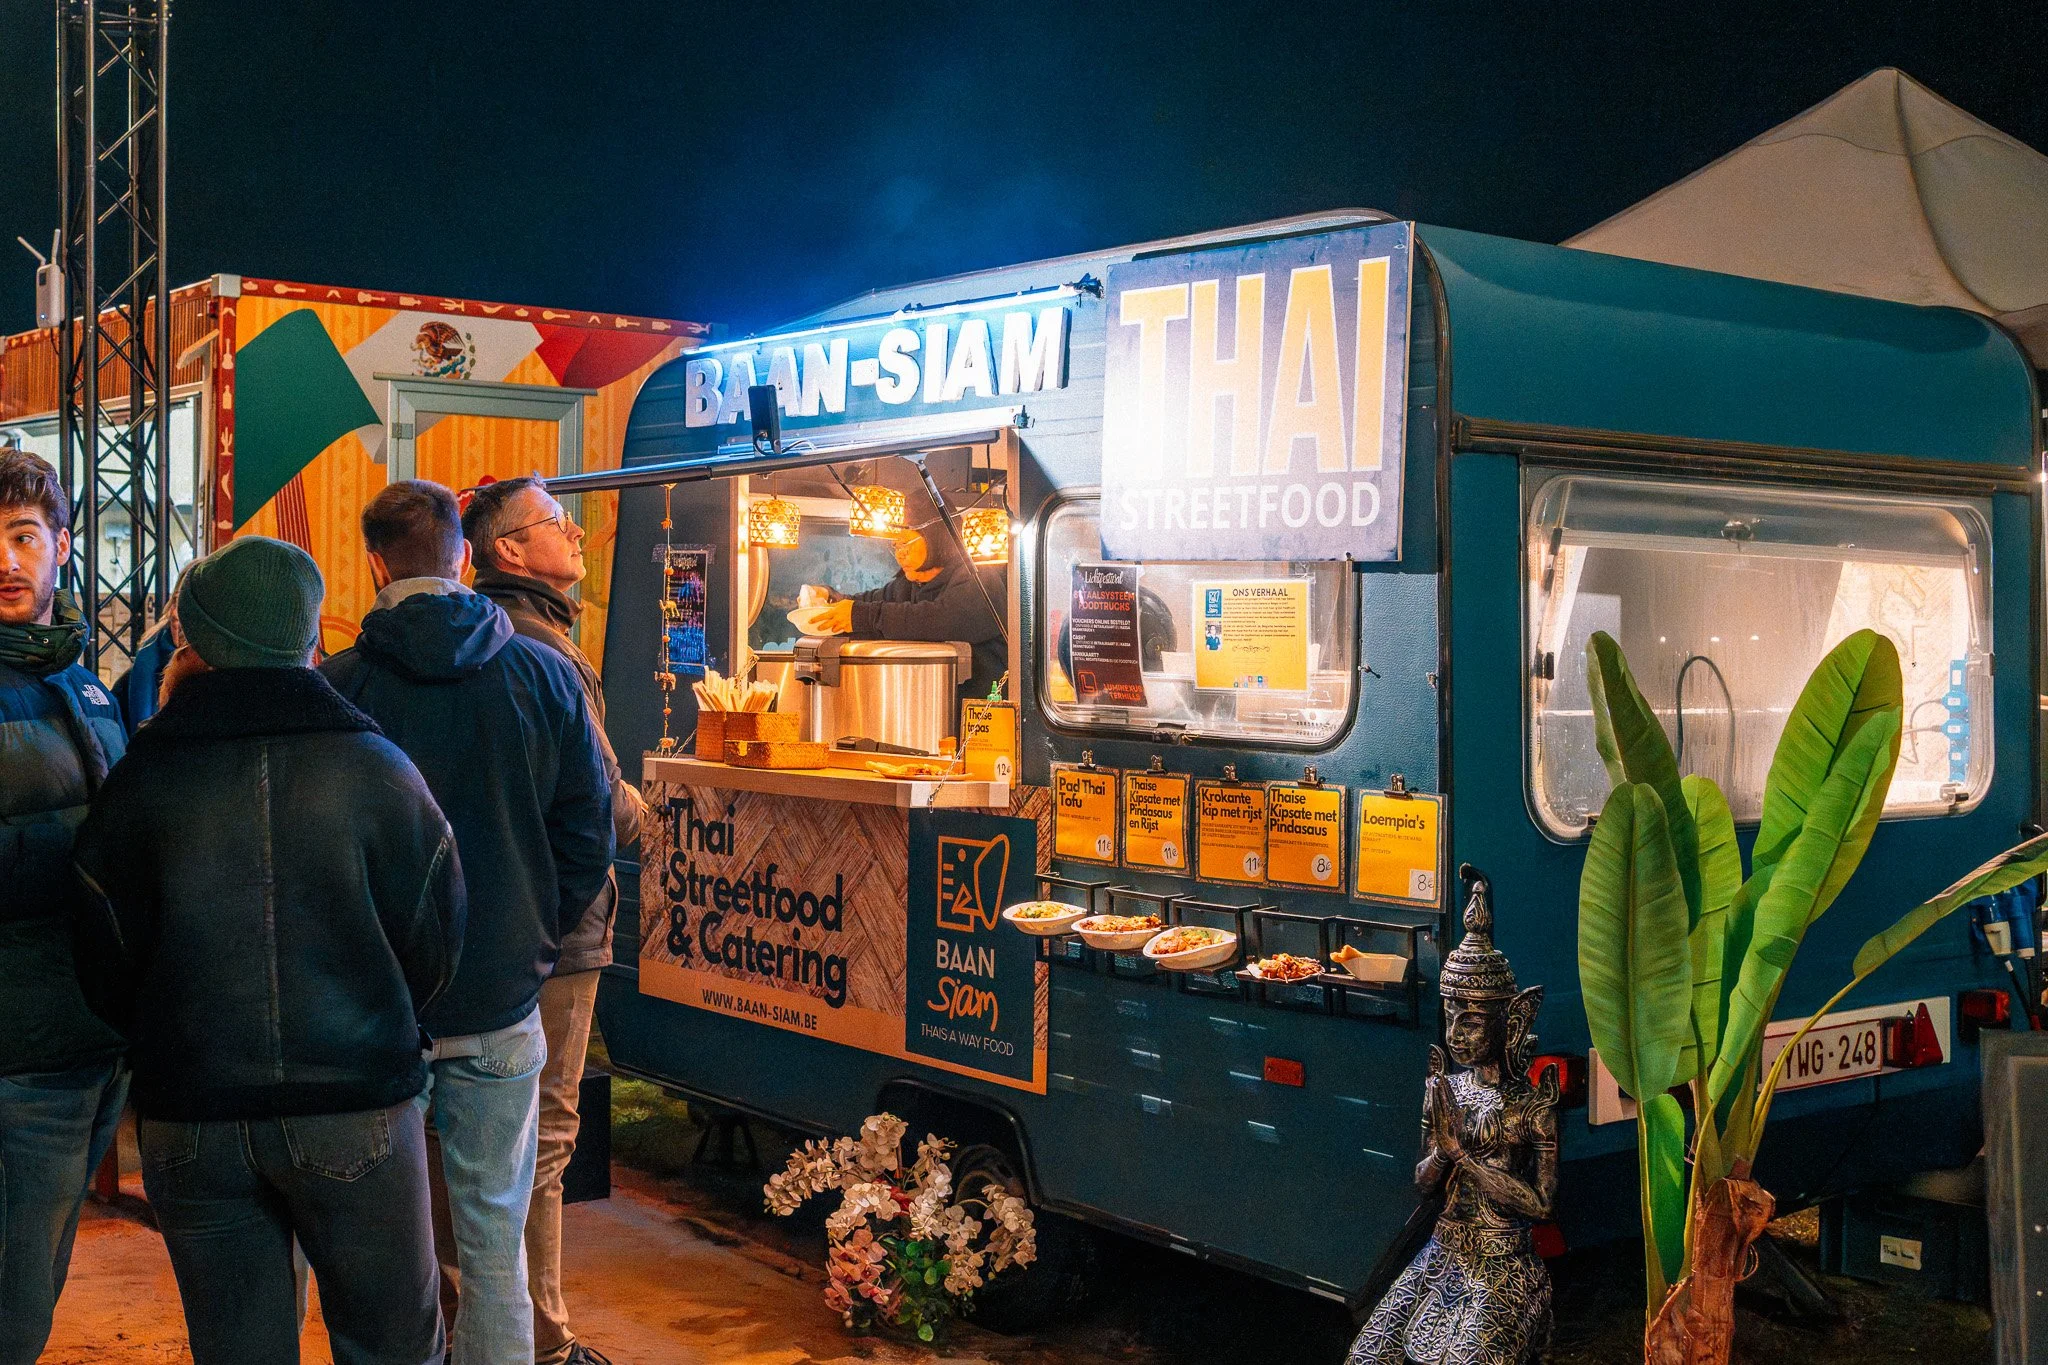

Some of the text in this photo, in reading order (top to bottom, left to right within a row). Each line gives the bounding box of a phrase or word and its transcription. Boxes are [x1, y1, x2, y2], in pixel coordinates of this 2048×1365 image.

[685, 306, 1070, 428] BAAN-SIAM
[1119, 255, 1391, 482] THAI
[1119, 481, 1381, 532] STREETFOOD
[1073, 590, 1135, 600] BTAALSYSTEEM
[1232, 588, 1288, 597] ONS VERHAAL
[968, 707, 992, 721] Thaise
[967, 721, 989, 736] tapas
[1059, 777, 1106, 796] Pad Thai
[1129, 777, 1157, 792] Thaise
[1059, 792, 1083, 809] Tofu
[1129, 790, 1181, 807] Kipsate met
[1201, 788, 1252, 805] Krokante
[1271, 788, 1307, 805] Thaise
[1129, 803, 1173, 820] Pindasaus
[1202, 802, 1263, 824] kip met rijst
[1270, 803, 1337, 823] Kipsate met
[1363, 808, 1426, 832] Loempia's
[668, 796, 735, 857] Thai
[1129, 817, 1159, 834] en Rijst
[1270, 817, 1328, 837] Pindasaus
[668, 850, 843, 932] Streetfood
[667, 904, 848, 1009] & Catering
[936, 938, 995, 980] BAAN
[702, 988, 818, 1031] WWW.BAAN-SIAM.BE
[926, 975, 1000, 1033] Siam
[948, 1030, 957, 1043] A
[958, 1031, 982, 1049] WAY
[983, 1037, 1014, 1057] FOOD
